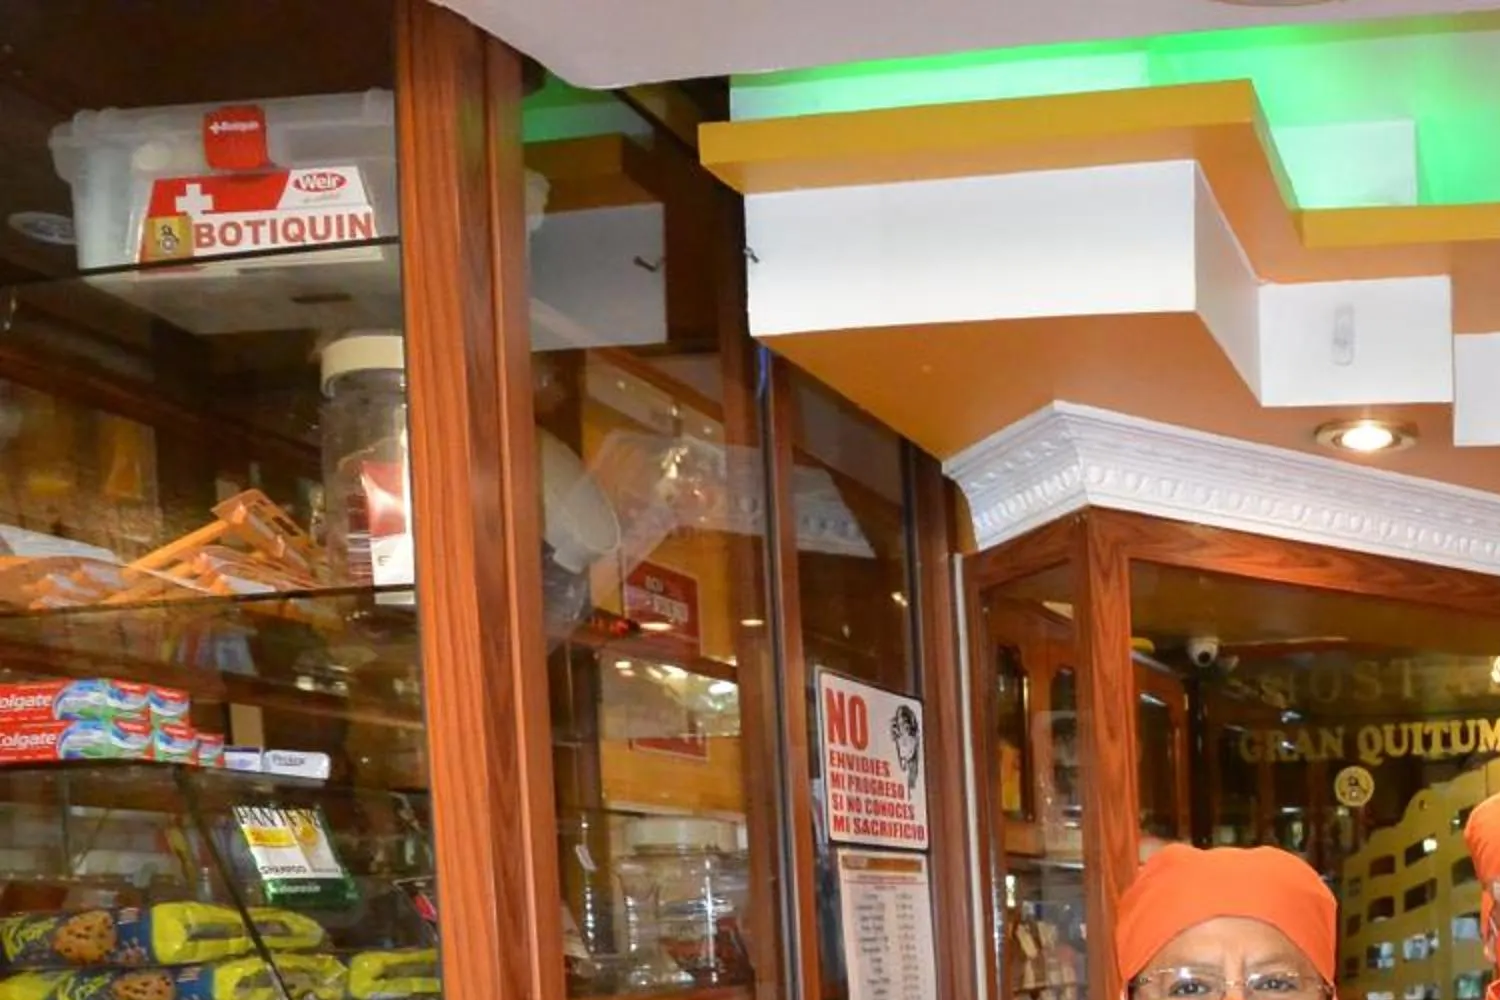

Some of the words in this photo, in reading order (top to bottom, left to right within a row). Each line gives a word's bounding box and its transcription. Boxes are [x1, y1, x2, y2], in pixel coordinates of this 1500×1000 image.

[302, 172, 338, 190] Weir
[194, 213, 373, 247] BOTIQUIN
[0, 694, 53, 710] olgate
[826, 688, 869, 750] NO
[1239, 726, 1345, 763] GRAN
[829, 751, 890, 777] ENVIDIES
[830, 772, 845, 791] MI
[847, 775, 905, 799] PROGRESO
[832, 794, 845, 811] SI
[847, 796, 862, 814] NO
[865, 799, 915, 821] CONOCES
[833, 815, 850, 834] MI
[853, 817, 925, 841] SACRIFICIO
